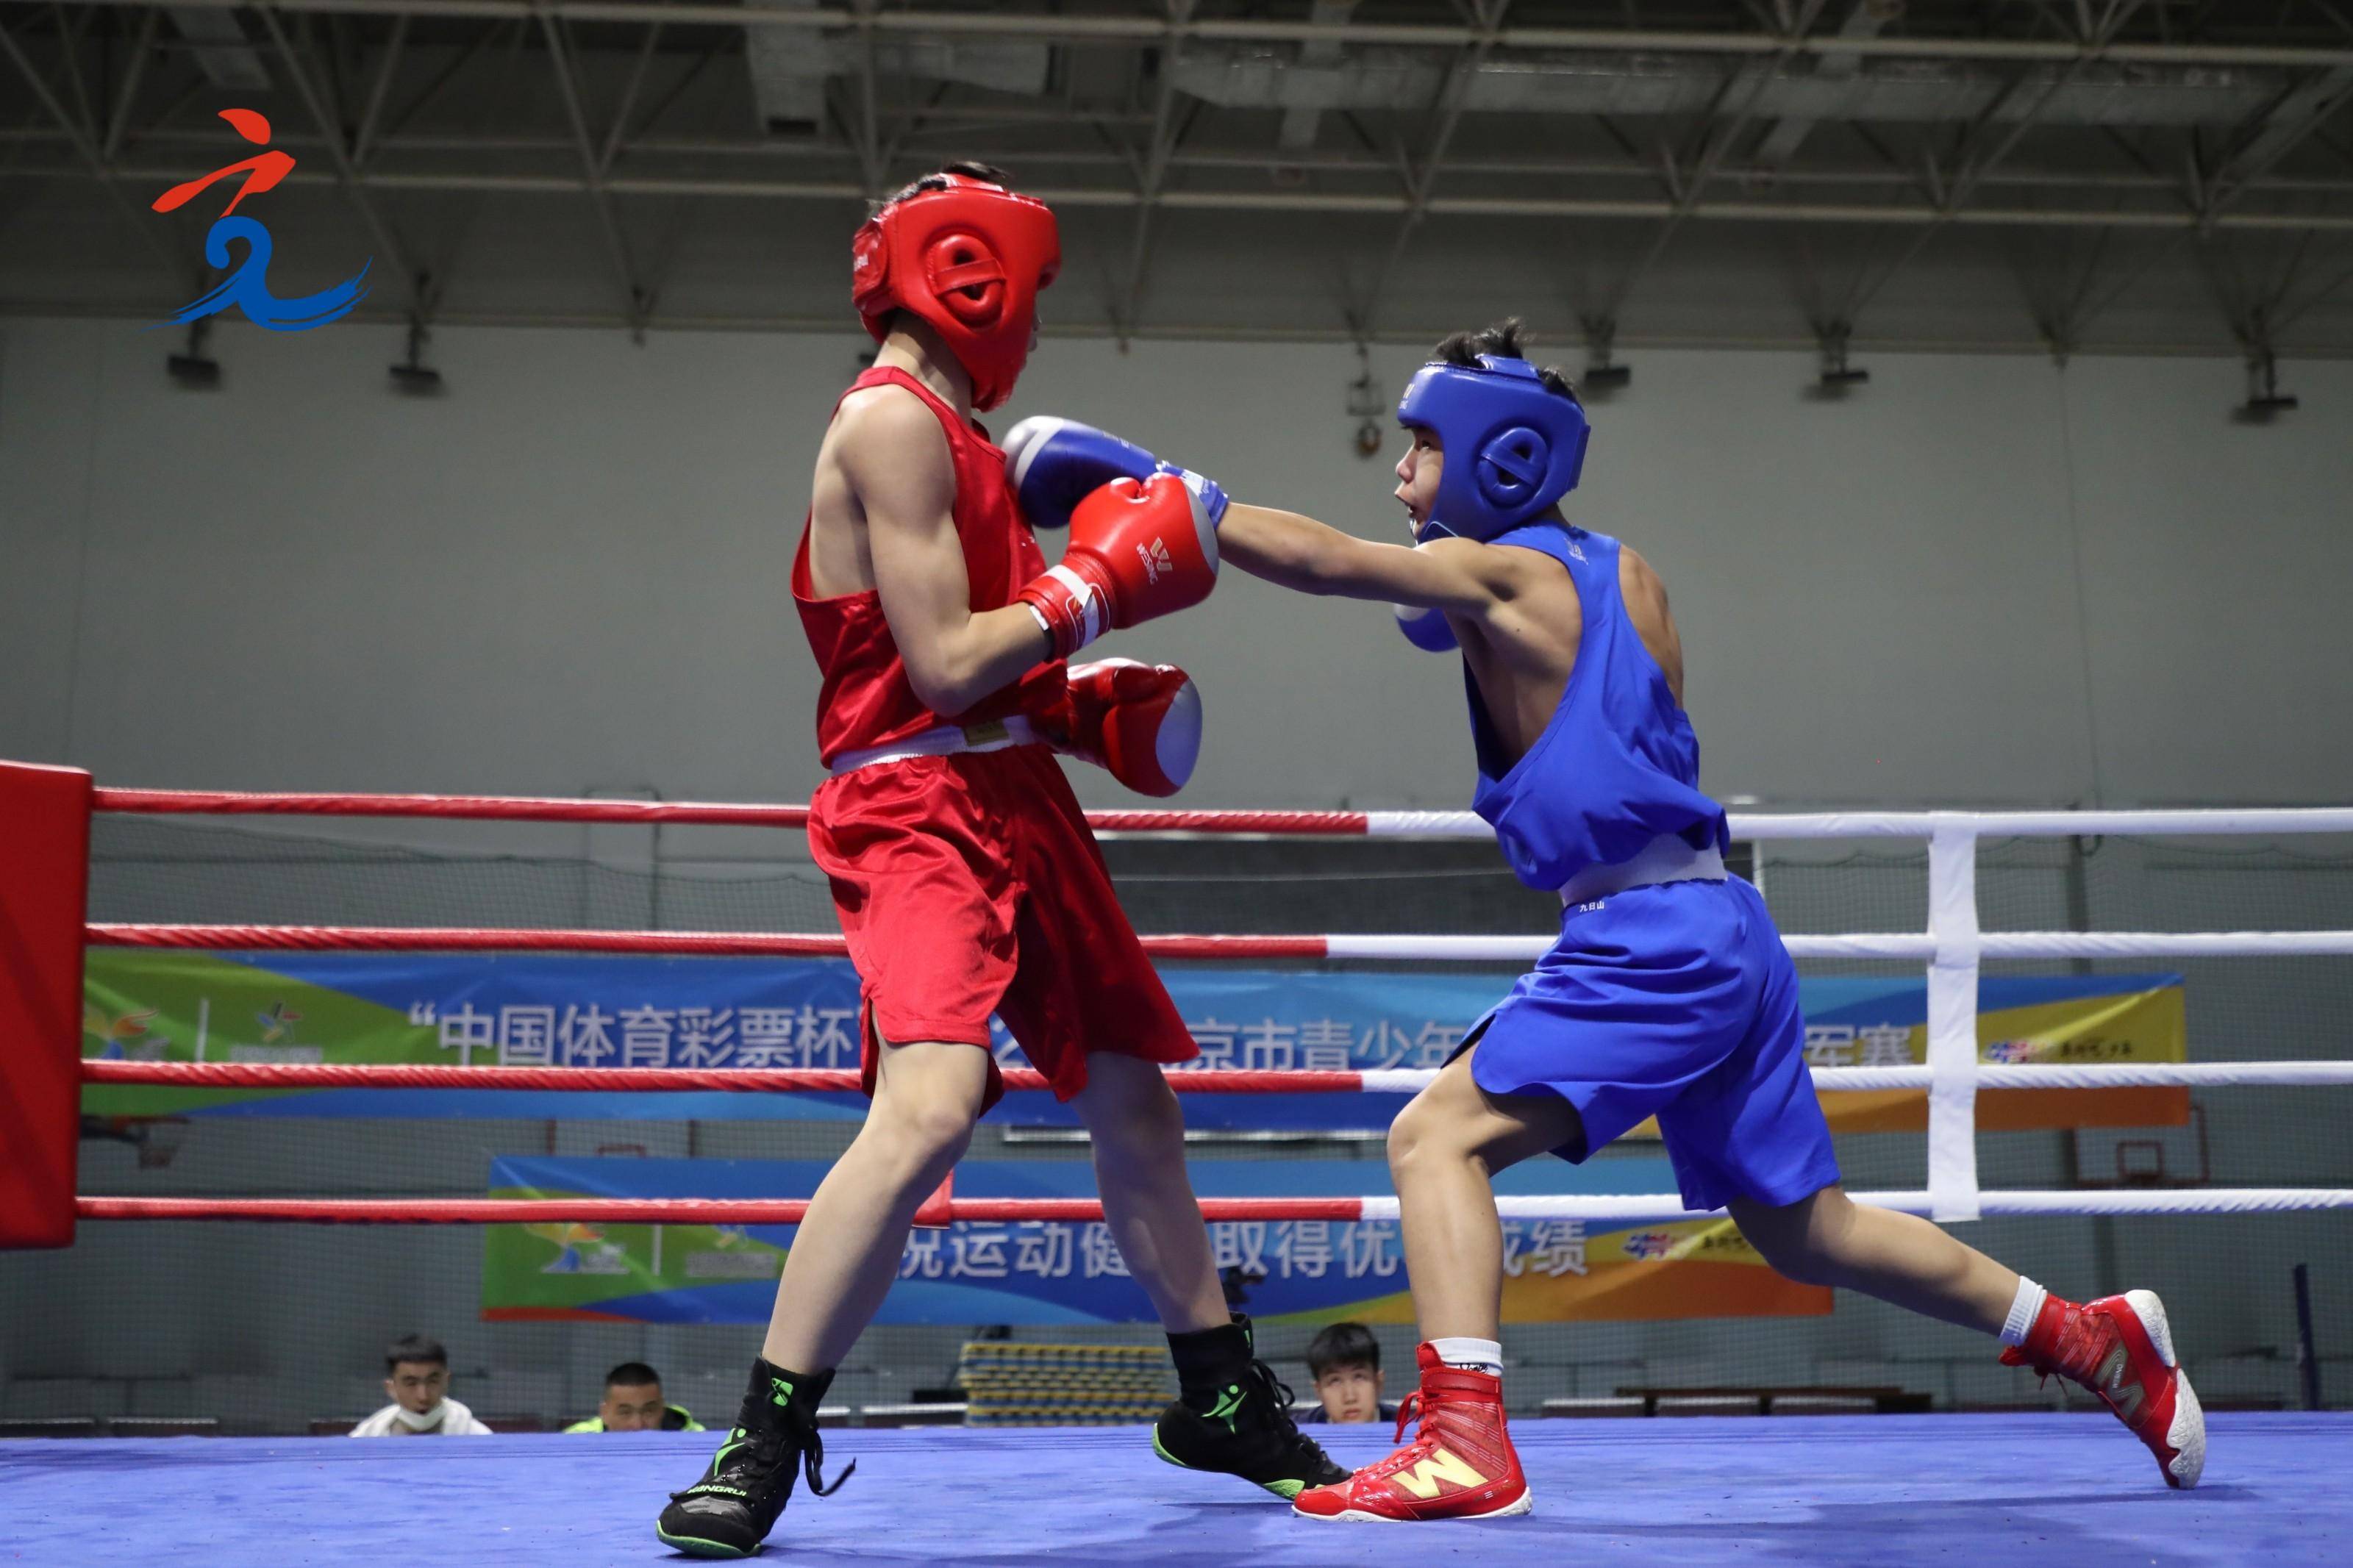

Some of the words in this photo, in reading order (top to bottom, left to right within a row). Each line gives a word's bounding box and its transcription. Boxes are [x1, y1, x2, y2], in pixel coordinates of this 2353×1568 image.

[1579, 900, 1604, 912] 九日山
[1214, 1220, 1398, 1278] 取得优
